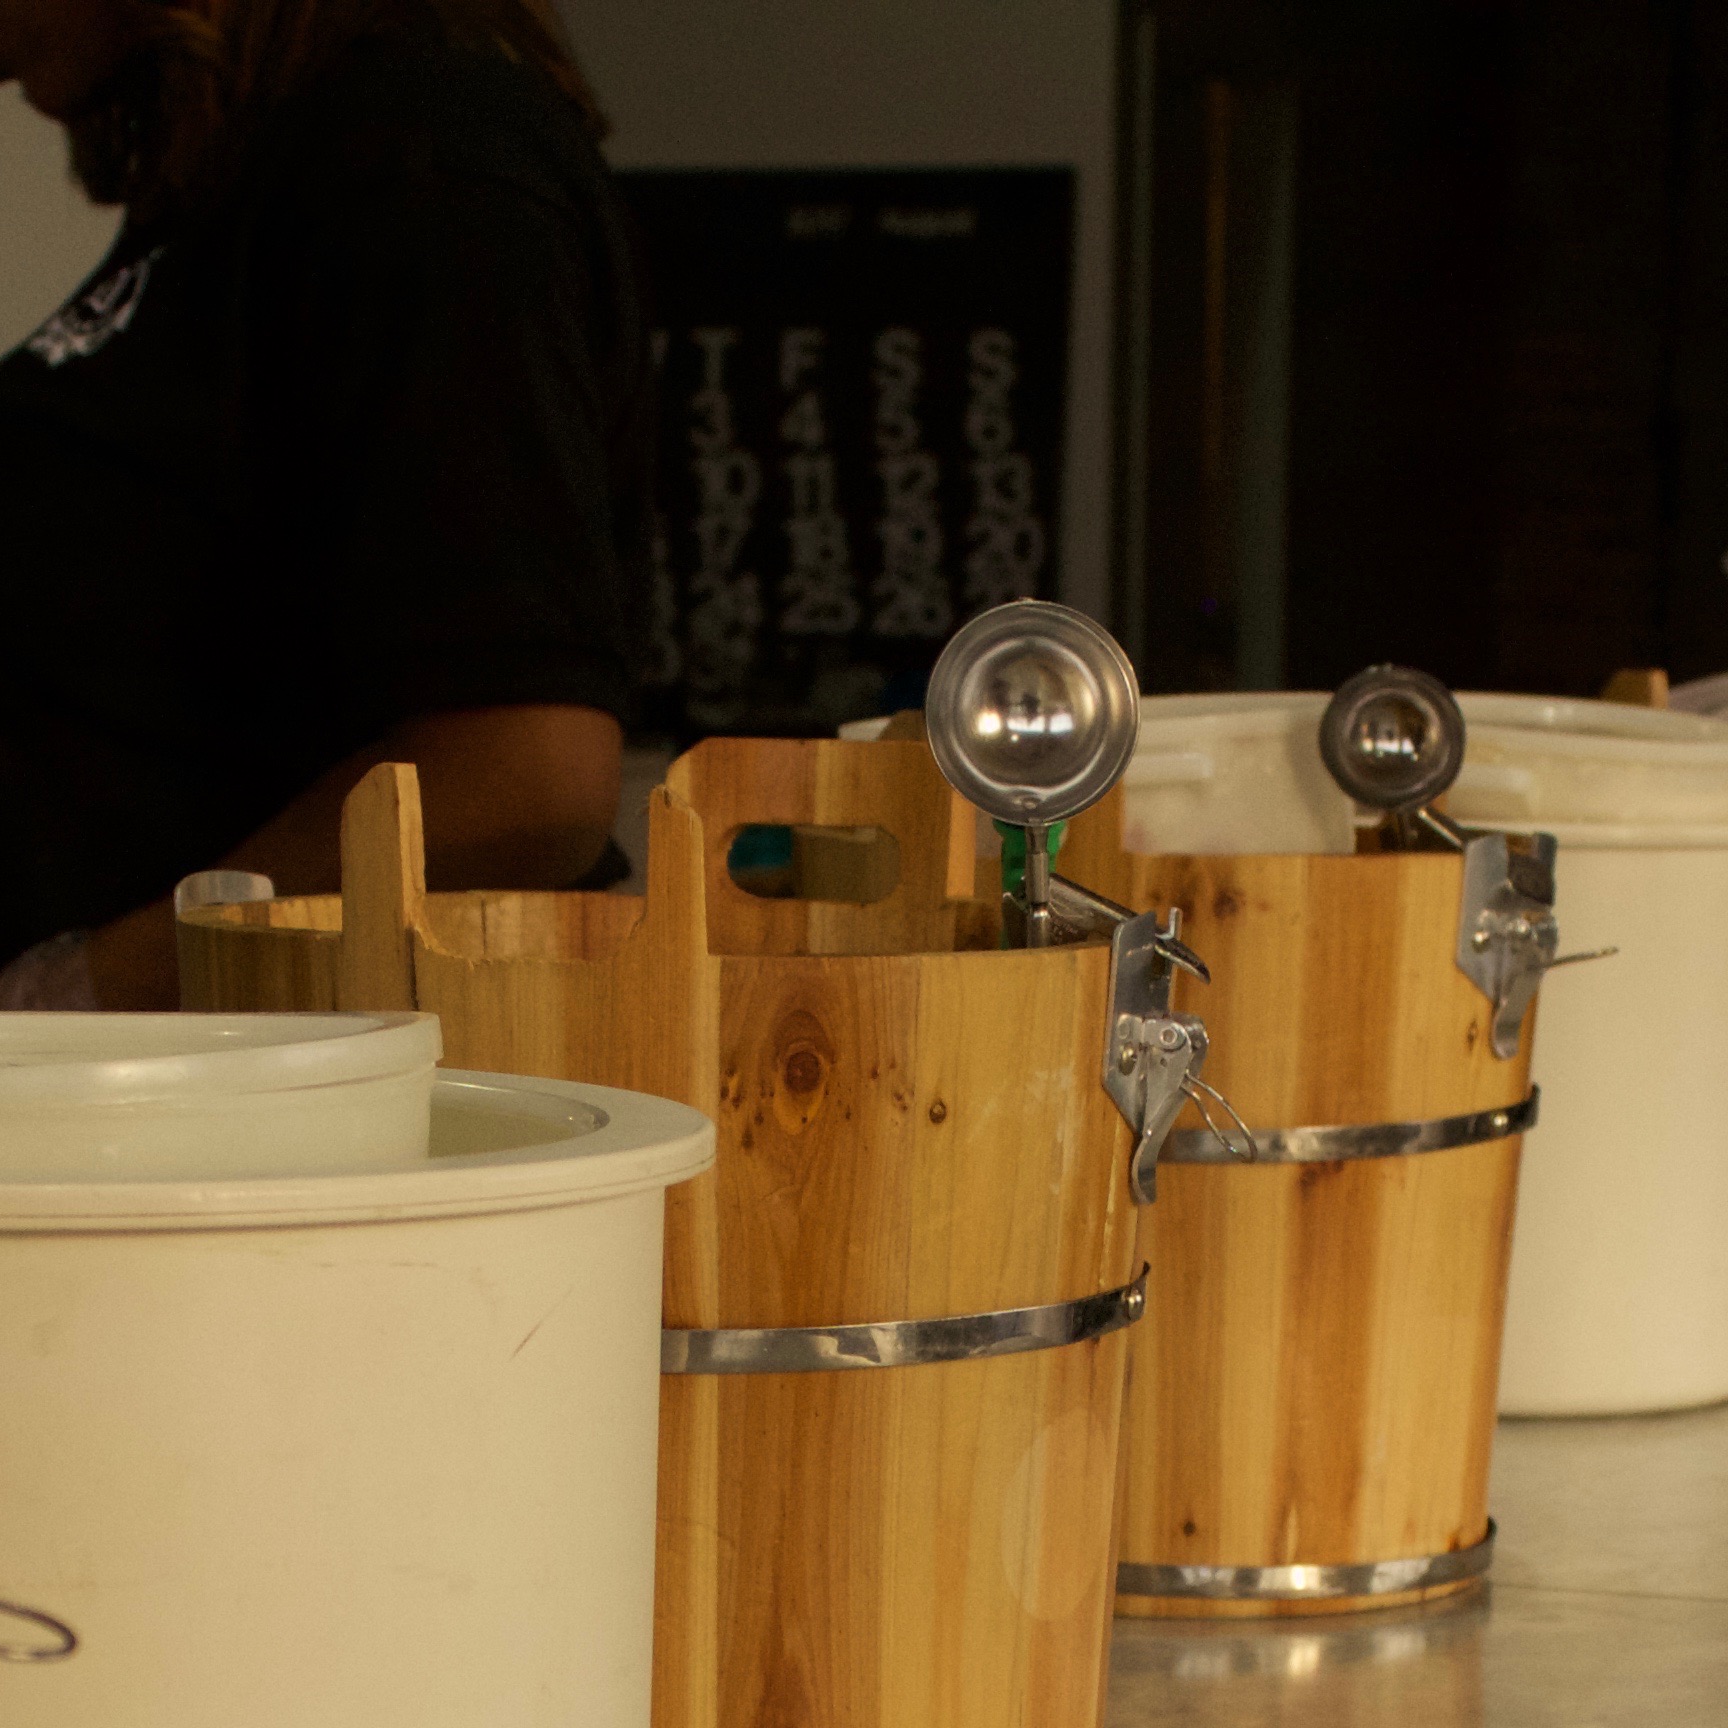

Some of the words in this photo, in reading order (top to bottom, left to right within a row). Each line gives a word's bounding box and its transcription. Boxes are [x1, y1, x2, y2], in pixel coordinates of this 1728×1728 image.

[690, 328, 739, 389] T
[780, 328, 823, 390] F
[872, 328, 921, 389] S
[967, 328, 1016, 390] S
[690, 390, 732, 450] 3
[780, 391, 824, 447] 4
[874, 390, 919, 451] 5
[966, 391, 1012, 451] 6
[692, 450, 761, 509] 10
[782, 452, 834, 513] 11
